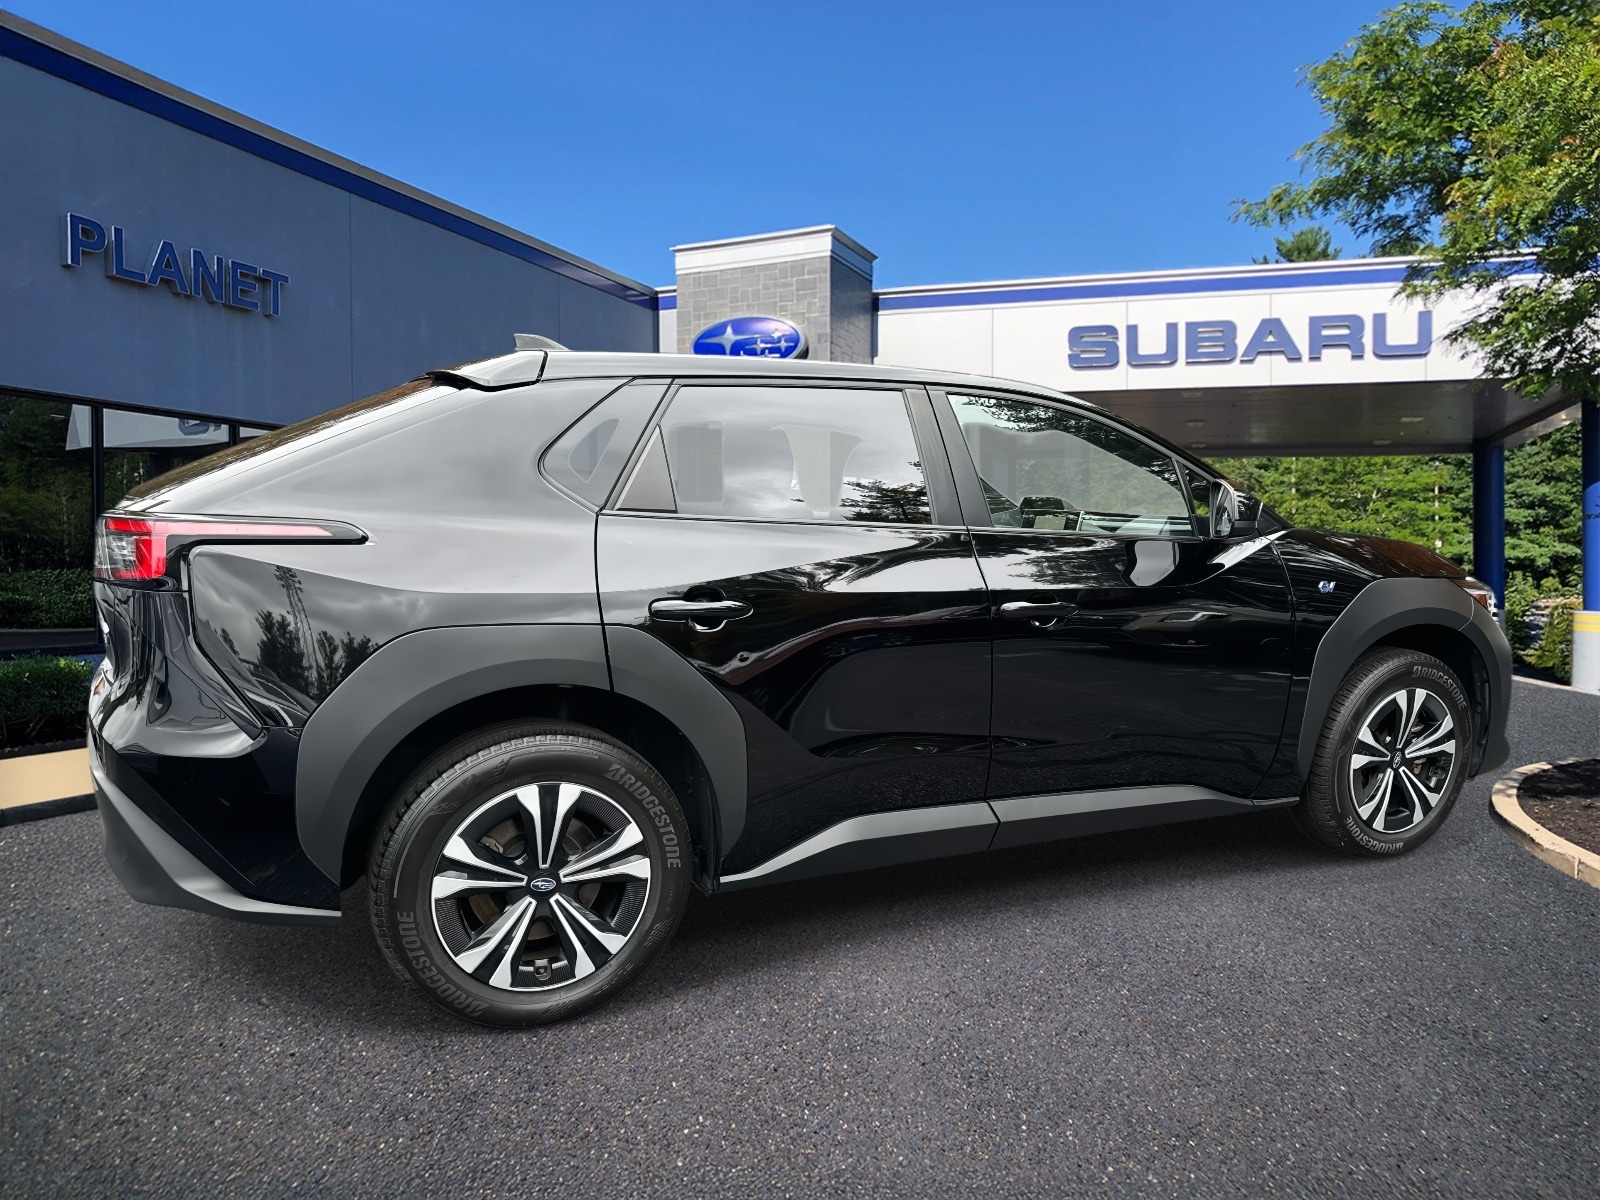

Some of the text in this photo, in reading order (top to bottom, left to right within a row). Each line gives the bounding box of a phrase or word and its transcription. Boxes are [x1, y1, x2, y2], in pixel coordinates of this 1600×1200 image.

[65, 212, 290, 317] PLANET
[1067, 309, 1433, 368] SUBARU
[1412, 665, 1467, 710] BRIDGESTONE
[603, 763, 682, 869] BRIDGESTONE
[1344, 815, 1405, 854] BRIDGESTONE
[396, 910, 490, 1017] BRIDGESTONE
